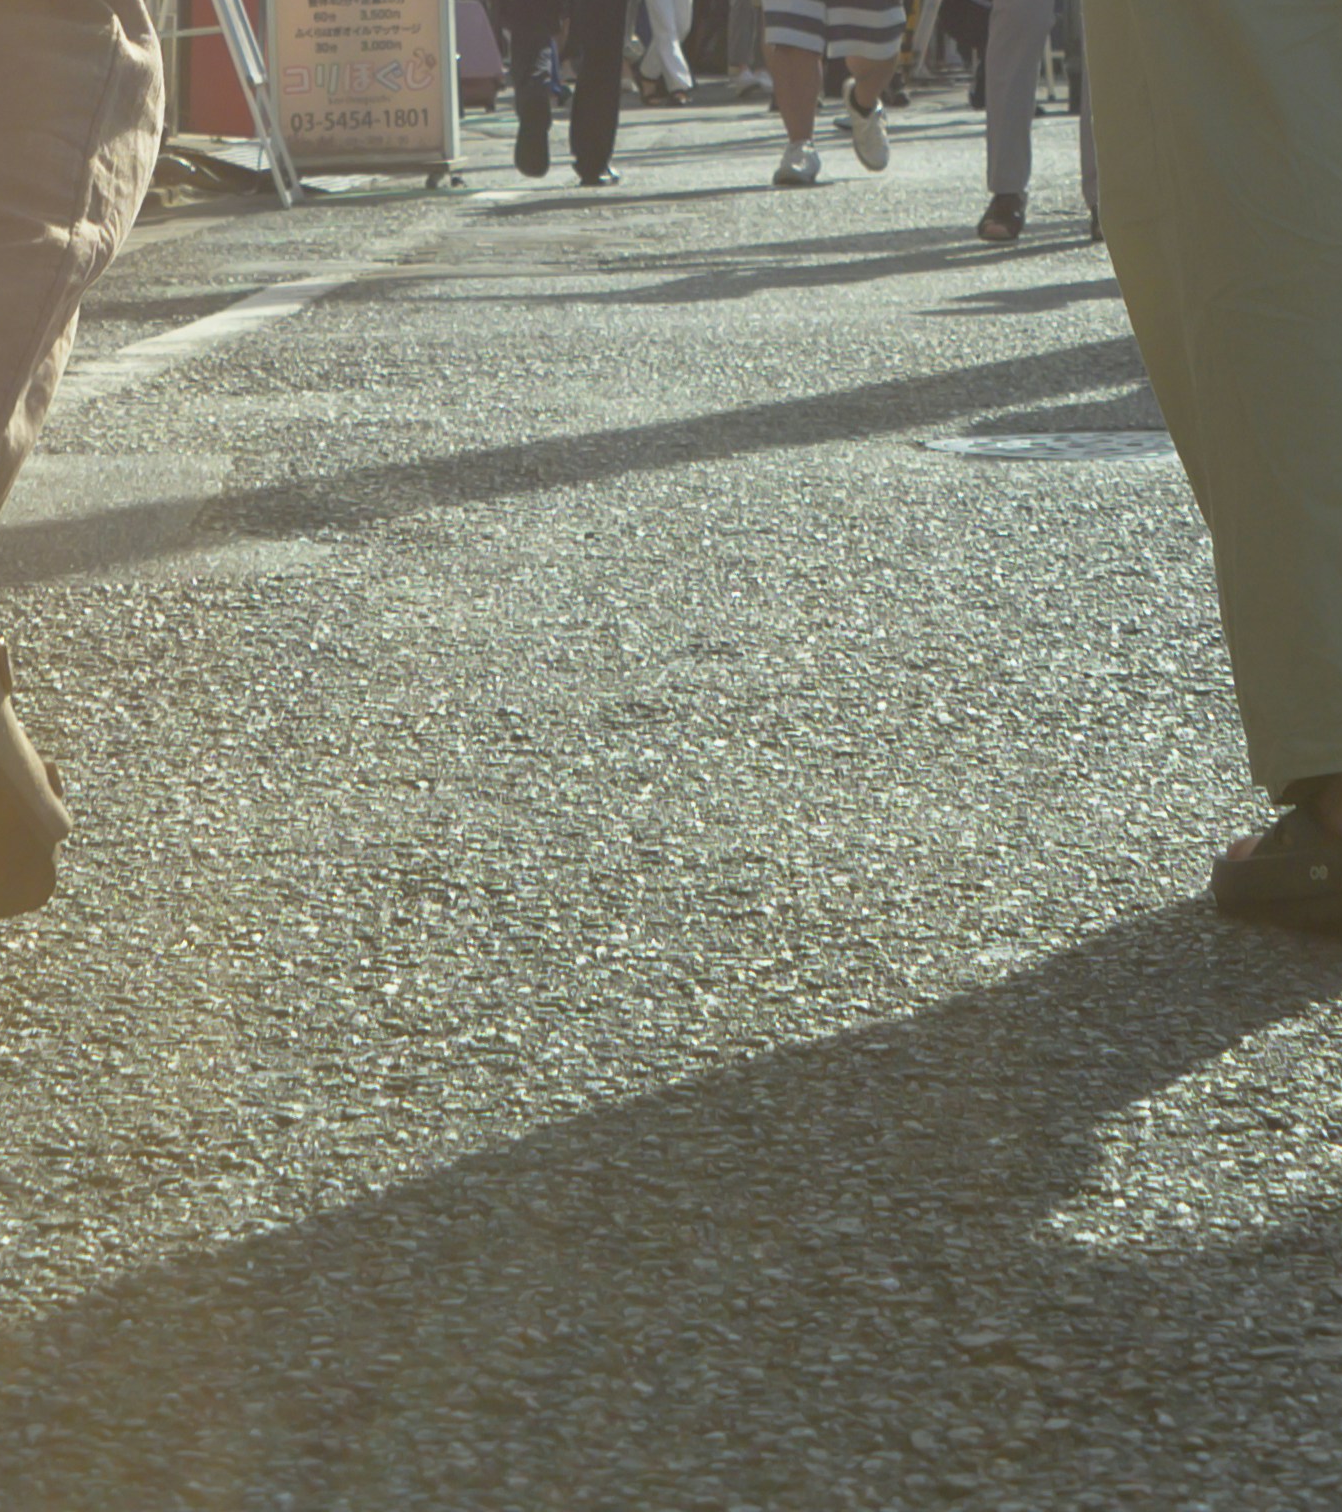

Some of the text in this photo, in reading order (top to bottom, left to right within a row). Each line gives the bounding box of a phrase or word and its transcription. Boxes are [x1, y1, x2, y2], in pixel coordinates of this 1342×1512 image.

[283, 60, 435, 96] コリほぐし
[290, 108, 430, 133] 03-5454-1801
